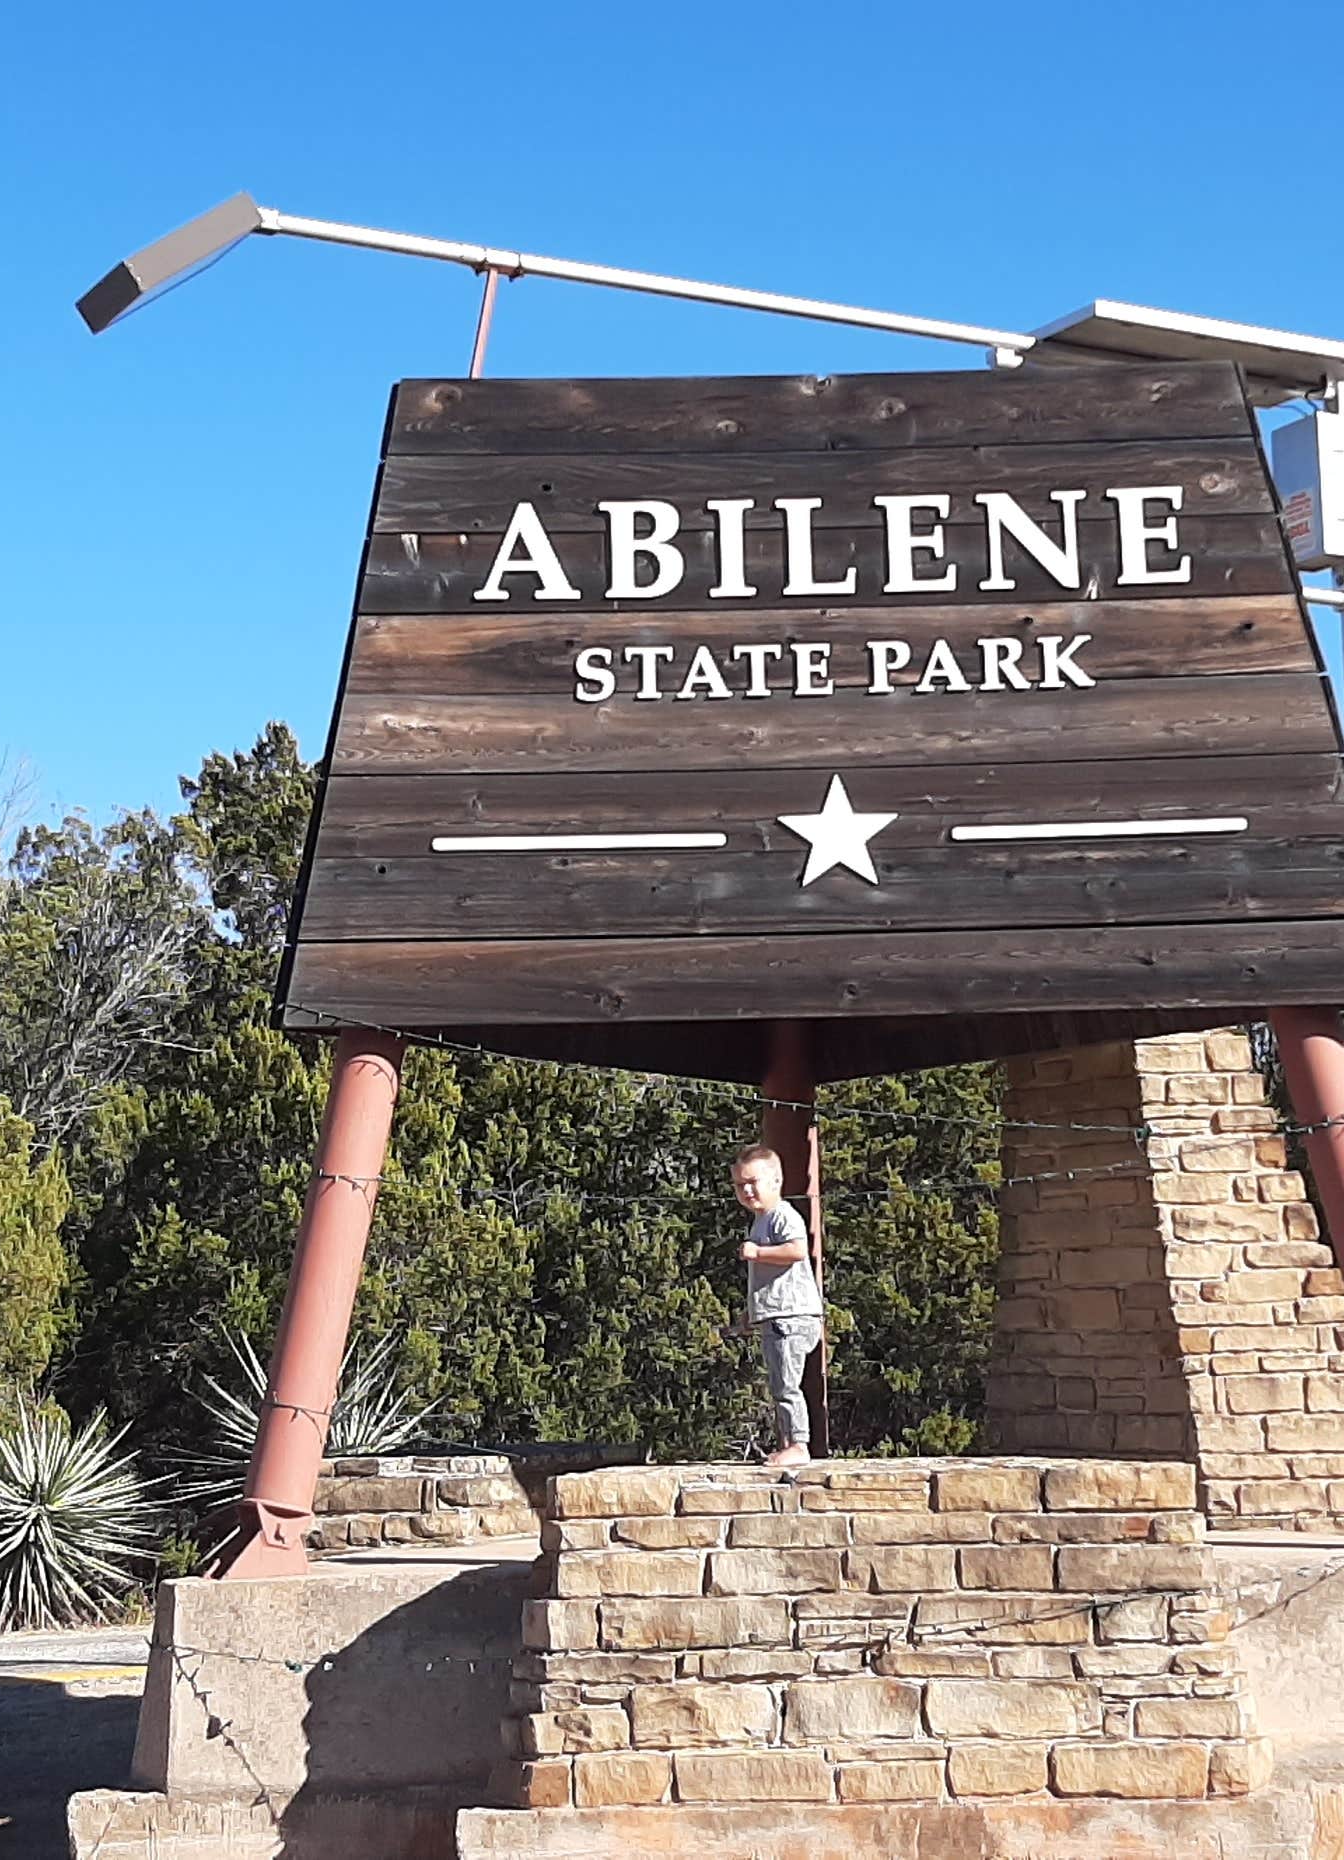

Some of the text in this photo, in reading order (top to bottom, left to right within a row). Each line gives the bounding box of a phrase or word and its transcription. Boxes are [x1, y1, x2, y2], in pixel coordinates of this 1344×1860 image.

[472, 484, 1195, 602] ABILENE
[574, 634, 1098, 703] STATE PARK
